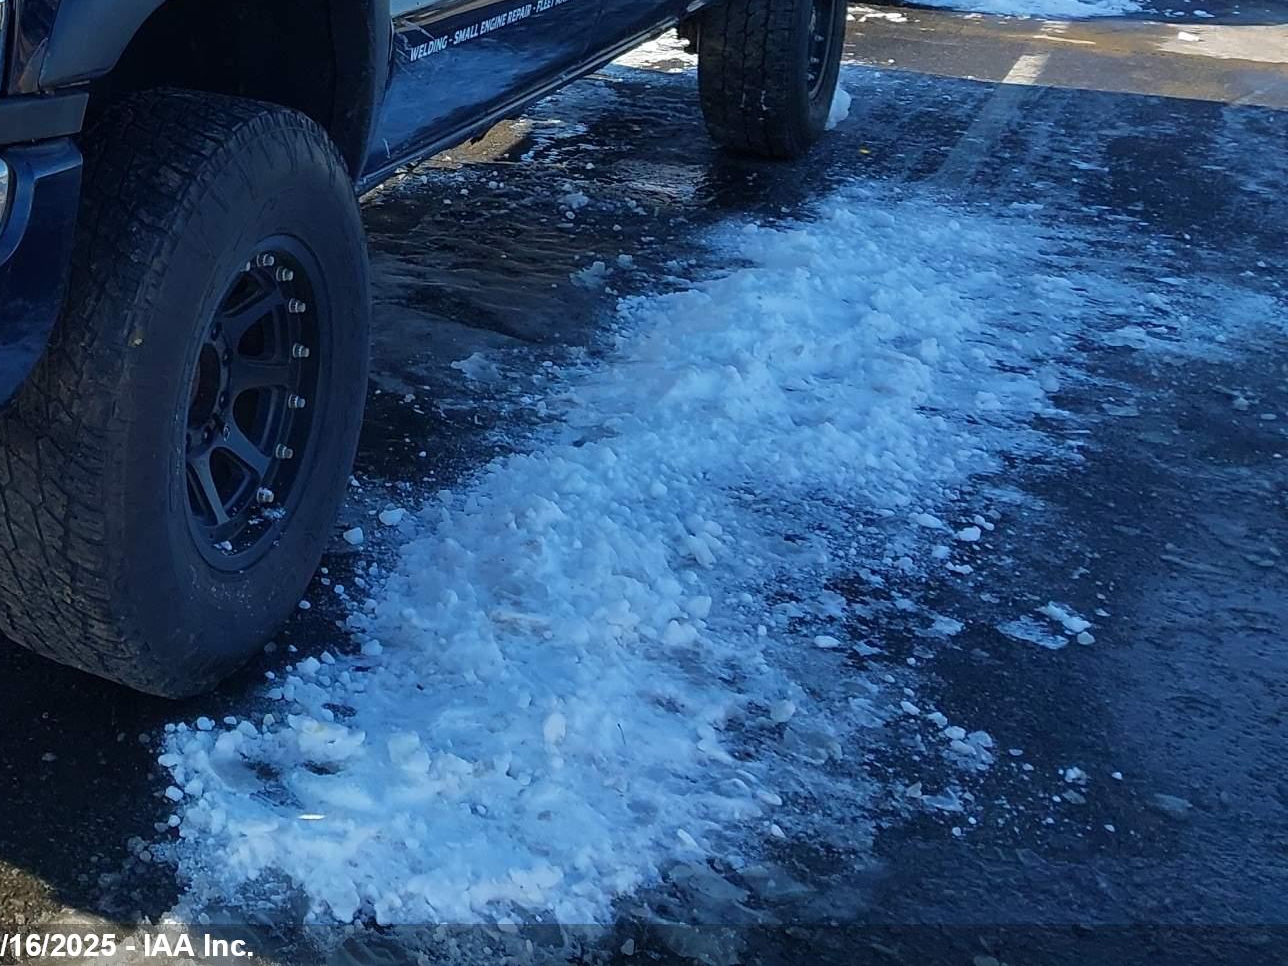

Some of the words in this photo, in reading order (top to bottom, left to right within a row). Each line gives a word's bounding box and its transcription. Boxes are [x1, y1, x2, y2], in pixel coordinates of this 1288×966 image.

[410, 35, 448, 61] WELDING
[453, 24, 479, 45] SMALL
[480, 13, 507, 35] ENGINE
[507, 4, 532, 25] REPAIR
